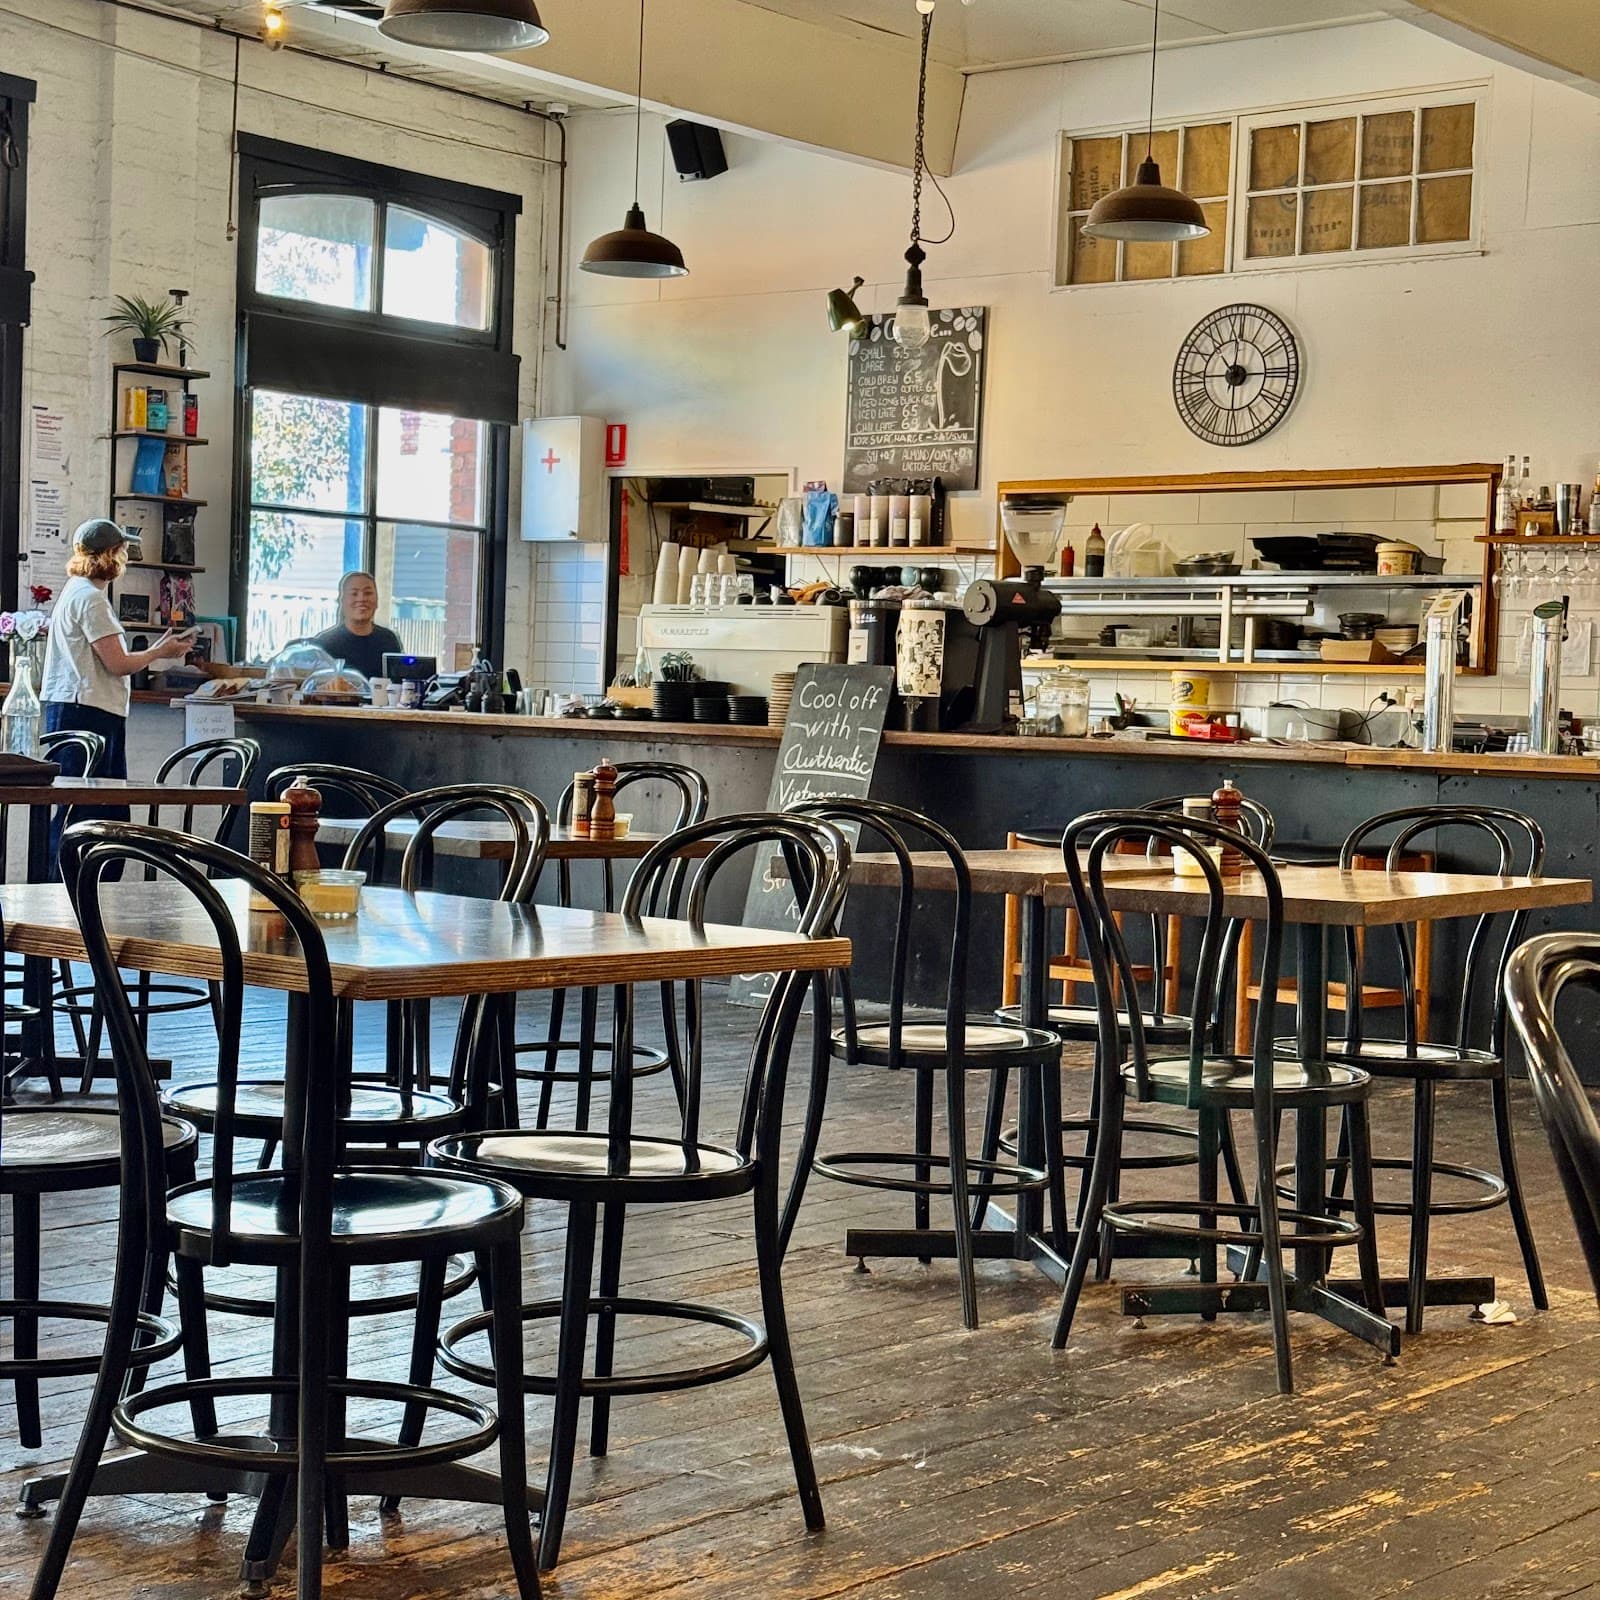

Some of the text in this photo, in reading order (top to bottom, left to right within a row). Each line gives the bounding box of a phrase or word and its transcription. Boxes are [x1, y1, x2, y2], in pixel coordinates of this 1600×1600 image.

[860, 346, 886, 361] SMALL
[860, 361, 885, 373] LARGE
[858, 376, 876, 386] COLD
[877, 375, 898, 385] BREW
[859, 386, 877, 397] VIET
[880, 386, 897, 394] ICED
[878, 397, 899, 406] LONG
[853, 436, 869, 446] 10%
[870, 434, 923, 445] SURCHARGE
[902, 462, 931, 471] LACTOSE
[800, 678, 883, 710] Cool off
[805, 714, 850, 740] with
[783, 743, 872, 775] Authentic
